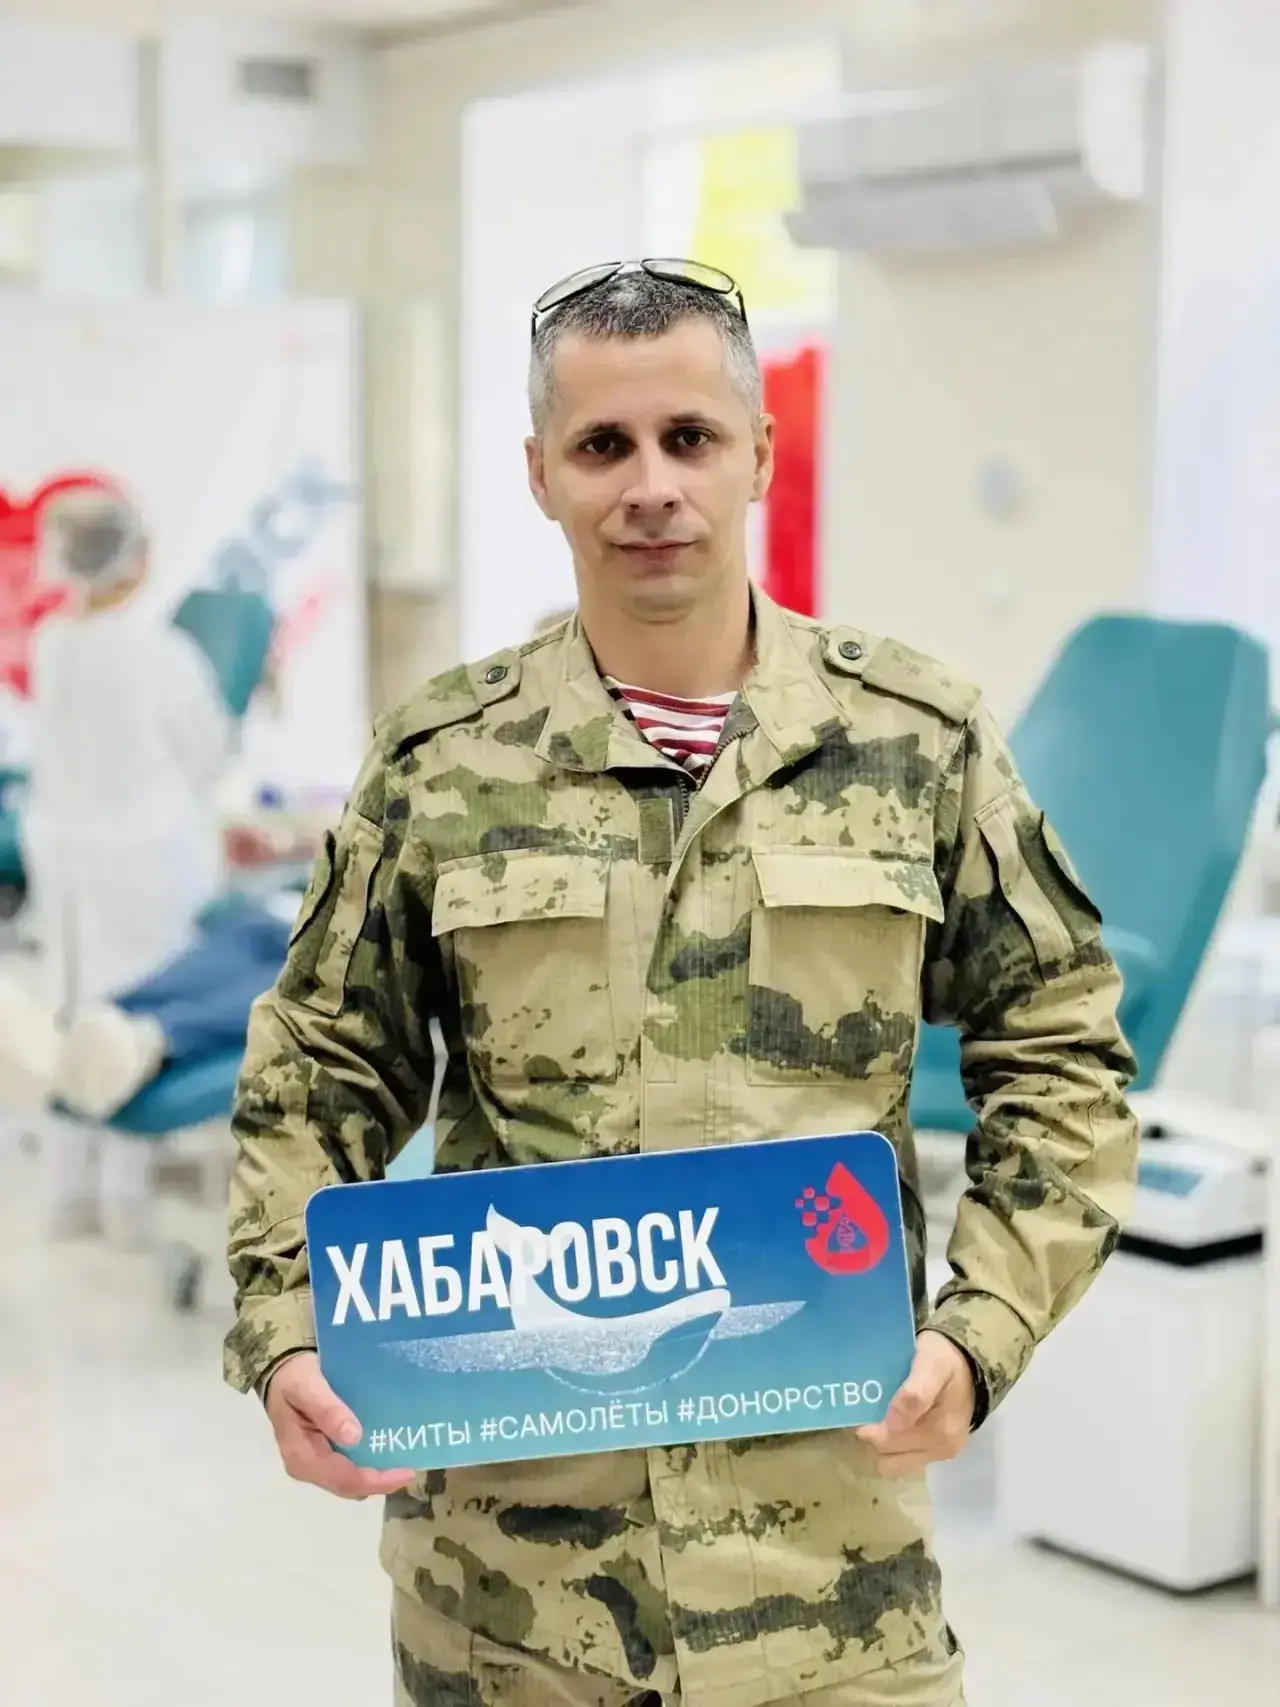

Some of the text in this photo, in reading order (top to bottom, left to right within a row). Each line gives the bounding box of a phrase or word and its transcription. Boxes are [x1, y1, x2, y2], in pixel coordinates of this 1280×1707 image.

[326, 1206, 727, 1325] ХАБАРОВСК
[369, 1379, 883, 1453] #КИТЫ #САМОЛЁТЫ #ДОНОРСТВО
